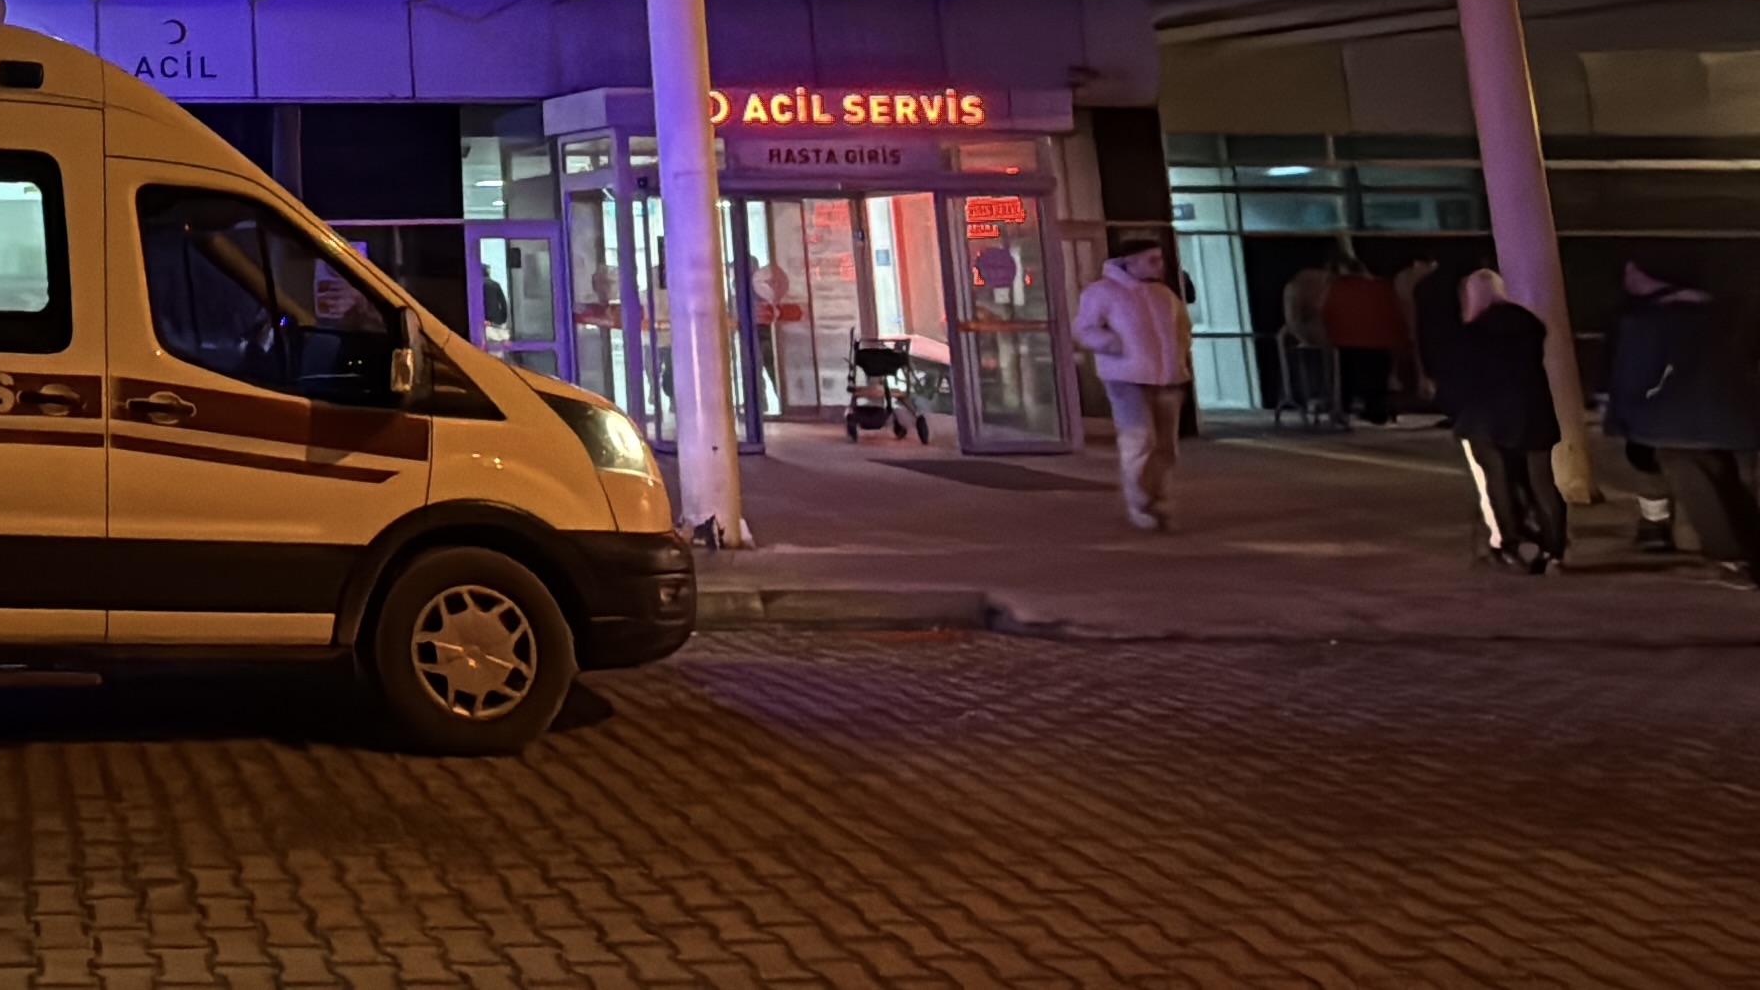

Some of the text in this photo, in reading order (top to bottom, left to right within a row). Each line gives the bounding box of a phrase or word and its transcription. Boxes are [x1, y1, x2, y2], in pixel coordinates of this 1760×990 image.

[134, 51, 218, 78] ACİL
[742, 85, 986, 125] ACİL SERVİS
[768, 147, 838, 165] HASTA
